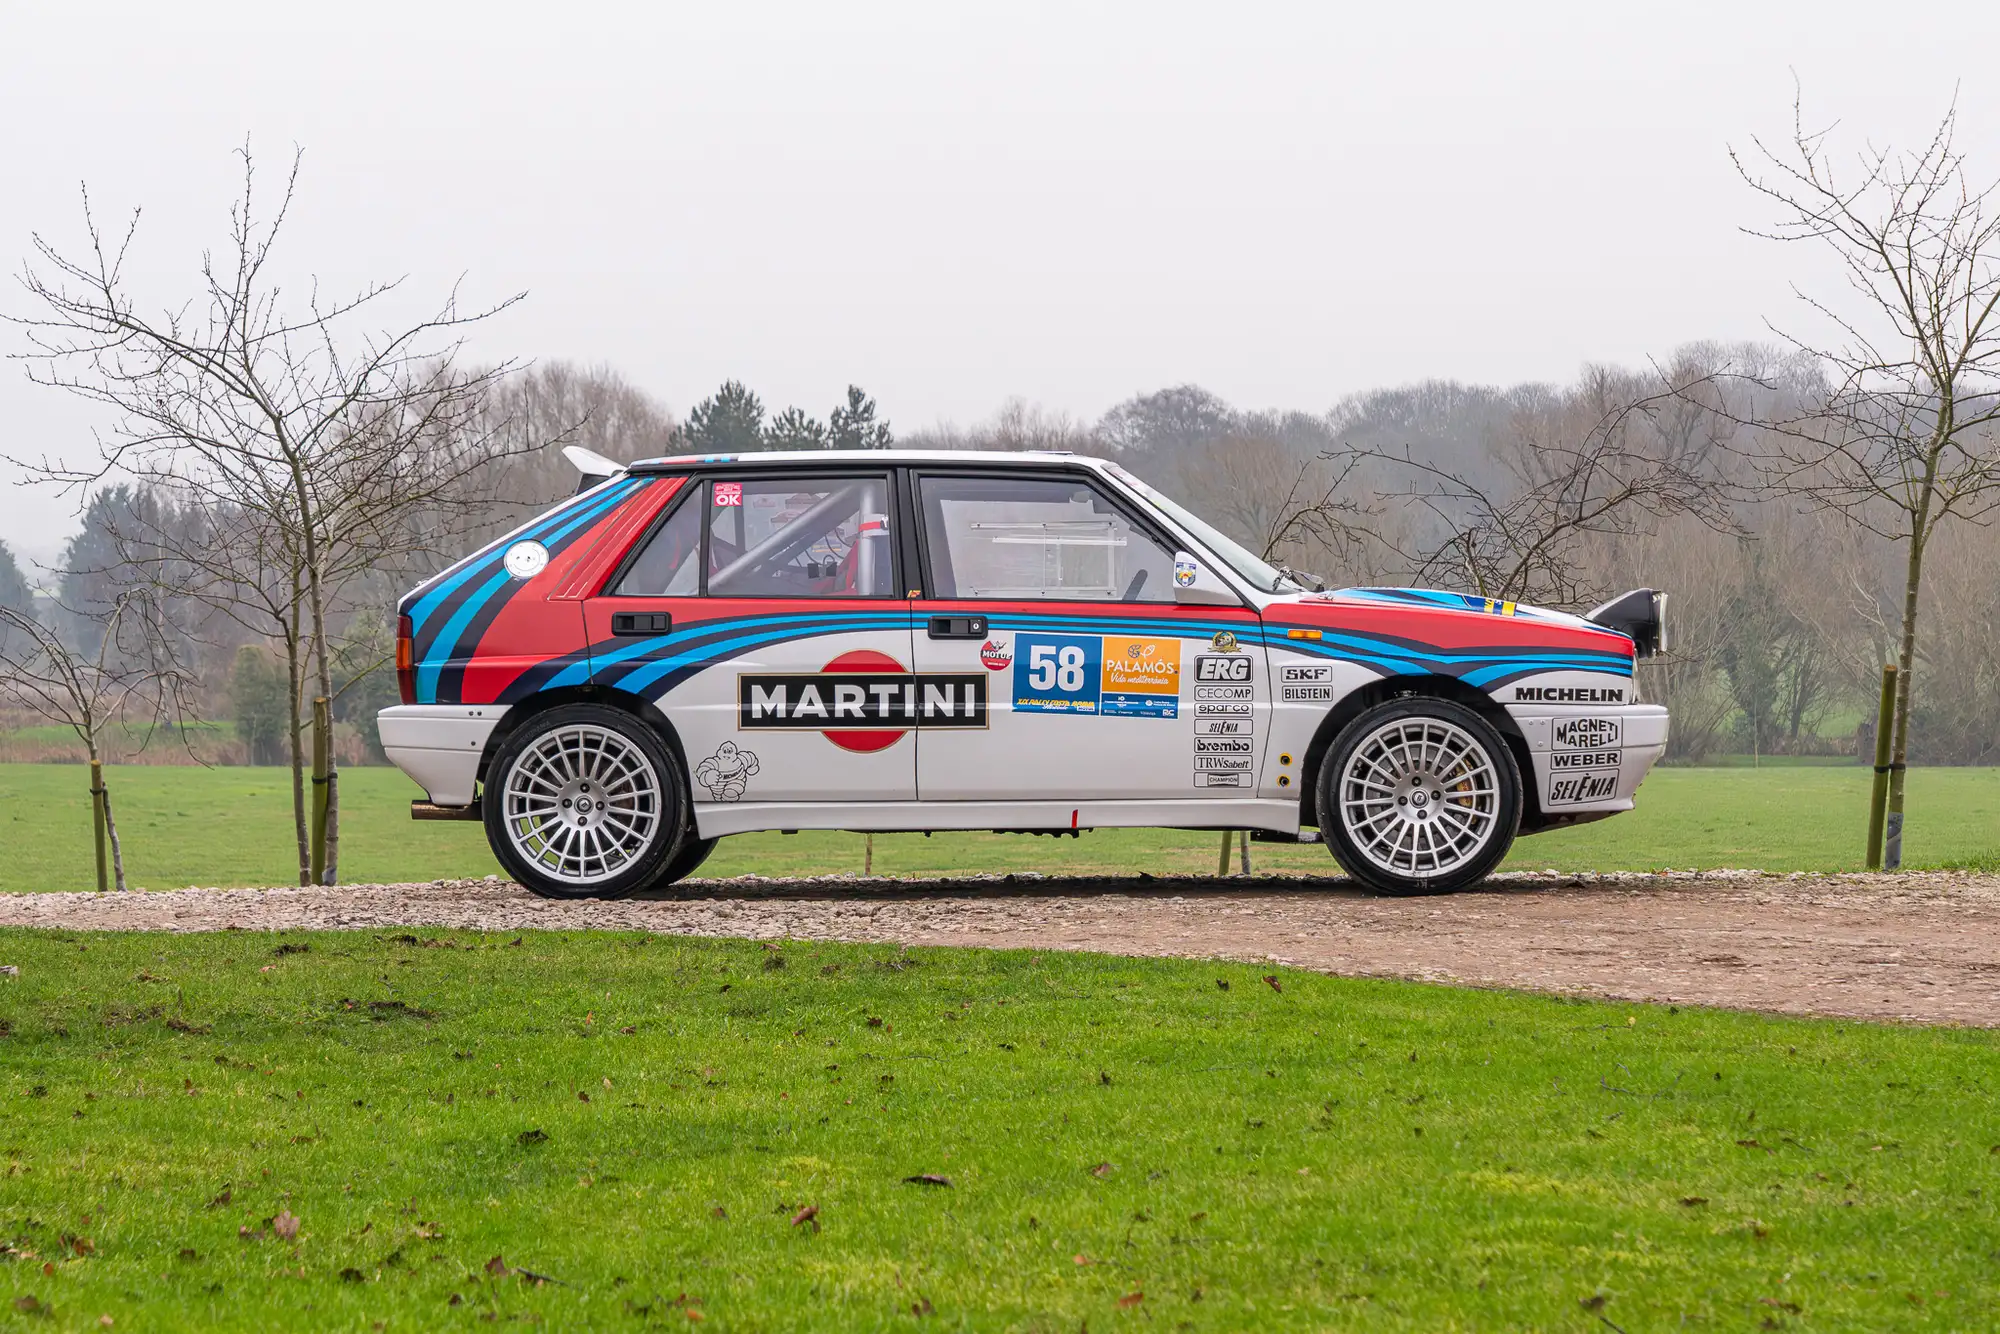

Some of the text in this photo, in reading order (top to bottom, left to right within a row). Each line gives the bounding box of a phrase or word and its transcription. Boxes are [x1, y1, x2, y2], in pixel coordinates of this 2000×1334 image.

[716, 494, 741, 506] OK
[982, 650, 1012, 660] MOTUL
[1029, 645, 1085, 691] 58
[1200, 658, 1249, 680] ERG
[1285, 669, 1328, 680] SKF
[1197, 687, 1251, 699] CECOMP
[1284, 688, 1331, 699] BILSTEIN
[1515, 687, 1623, 702] MICHELIN
[751, 683, 975, 719] MARTINI
[1198, 704, 1250, 714] sparco
[1196, 740, 1250, 752] brembo
[1554, 752, 1619, 767] WEBER
